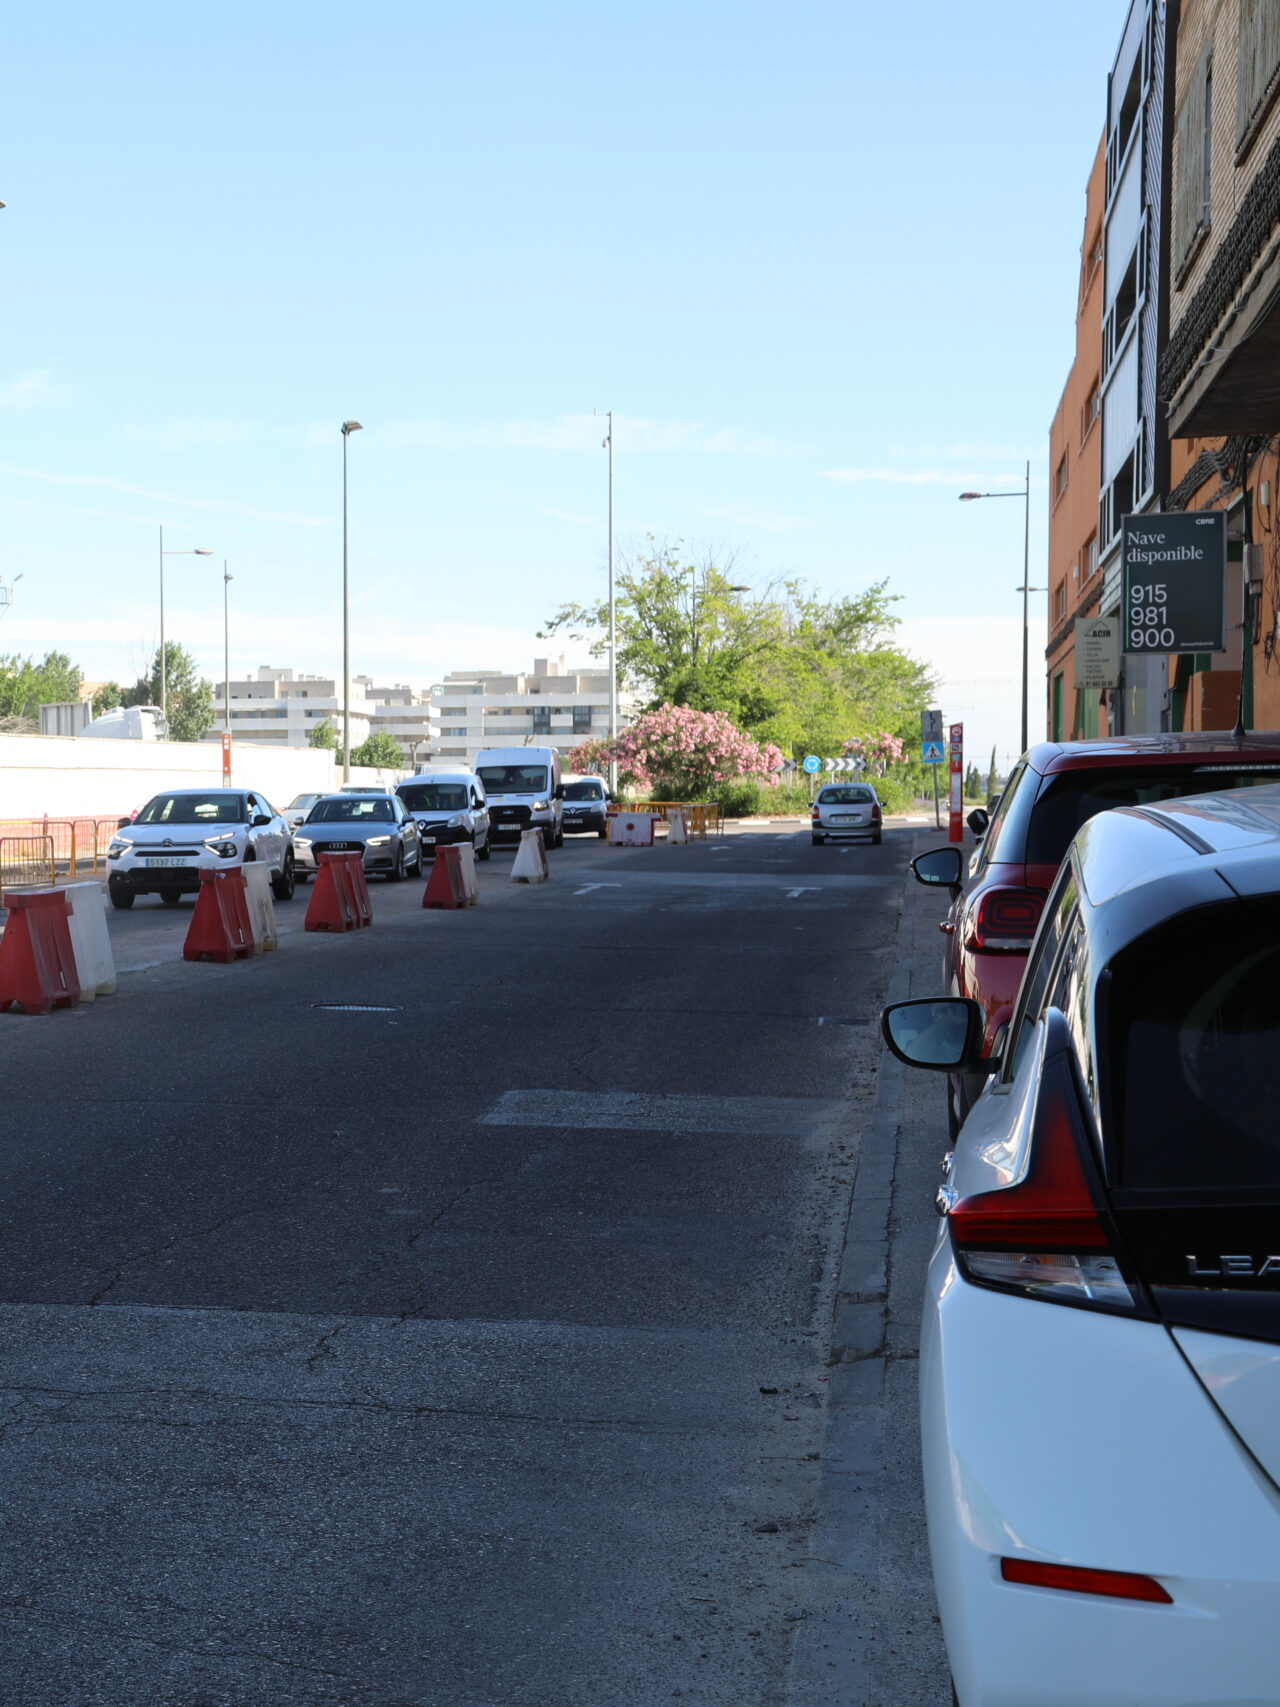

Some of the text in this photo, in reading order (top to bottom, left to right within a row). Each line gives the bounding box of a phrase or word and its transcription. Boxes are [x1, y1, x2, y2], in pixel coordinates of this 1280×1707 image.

[1127, 531, 1166, 546] Nave
[1127, 545, 1204, 565] disponible
[1130, 584, 1168, 604] 915
[1130, 606, 1167, 626] 981
[1092, 630, 1111, 638] ACIR
[1130, 628, 1175, 648] 900
